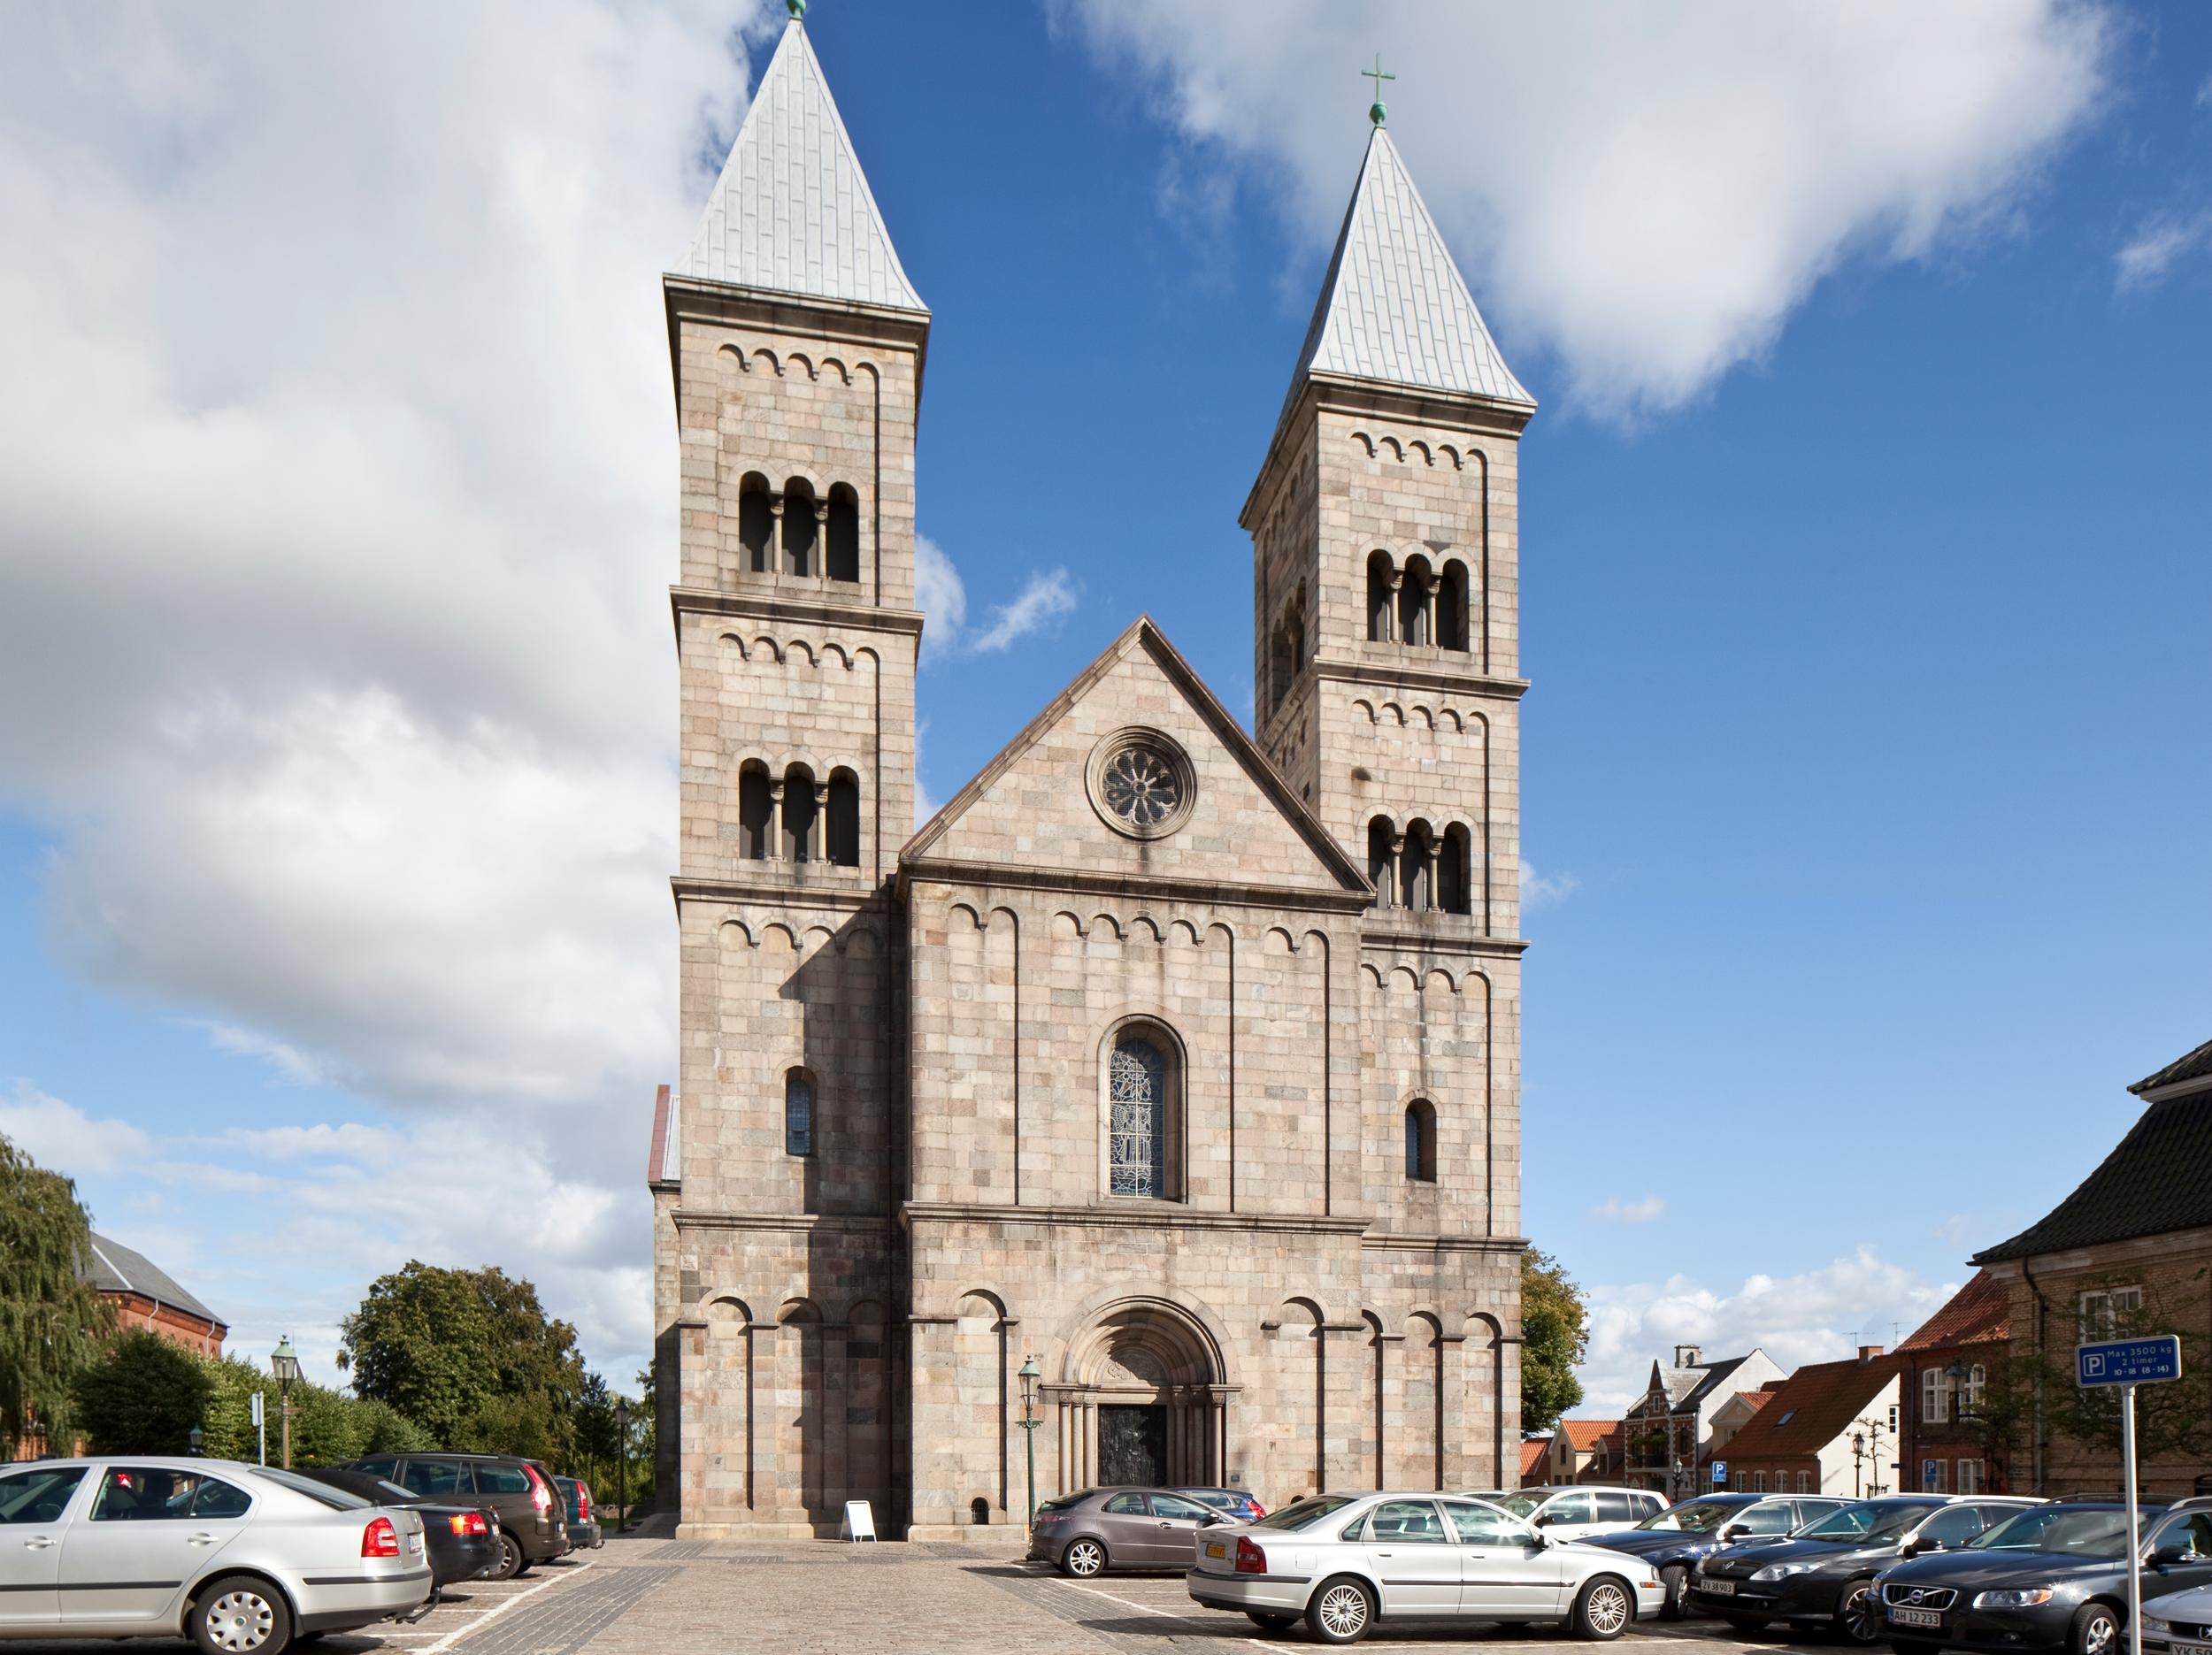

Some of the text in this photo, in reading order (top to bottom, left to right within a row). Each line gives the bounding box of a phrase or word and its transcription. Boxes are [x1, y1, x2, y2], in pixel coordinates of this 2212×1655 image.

[2131, 1346, 2156, 1356] 3500
[2161, 1345, 2172, 1354] kg
[2088, 1356, 2101, 1374] P
[2122, 1358, 2128, 1367] 2
[1716, 1464, 1724, 1474] P
[1927, 1461, 1935, 1474] P
[1894, 1611, 1939, 1625] AH 12 233
[2174, 1645, 2192, 1655] YK
